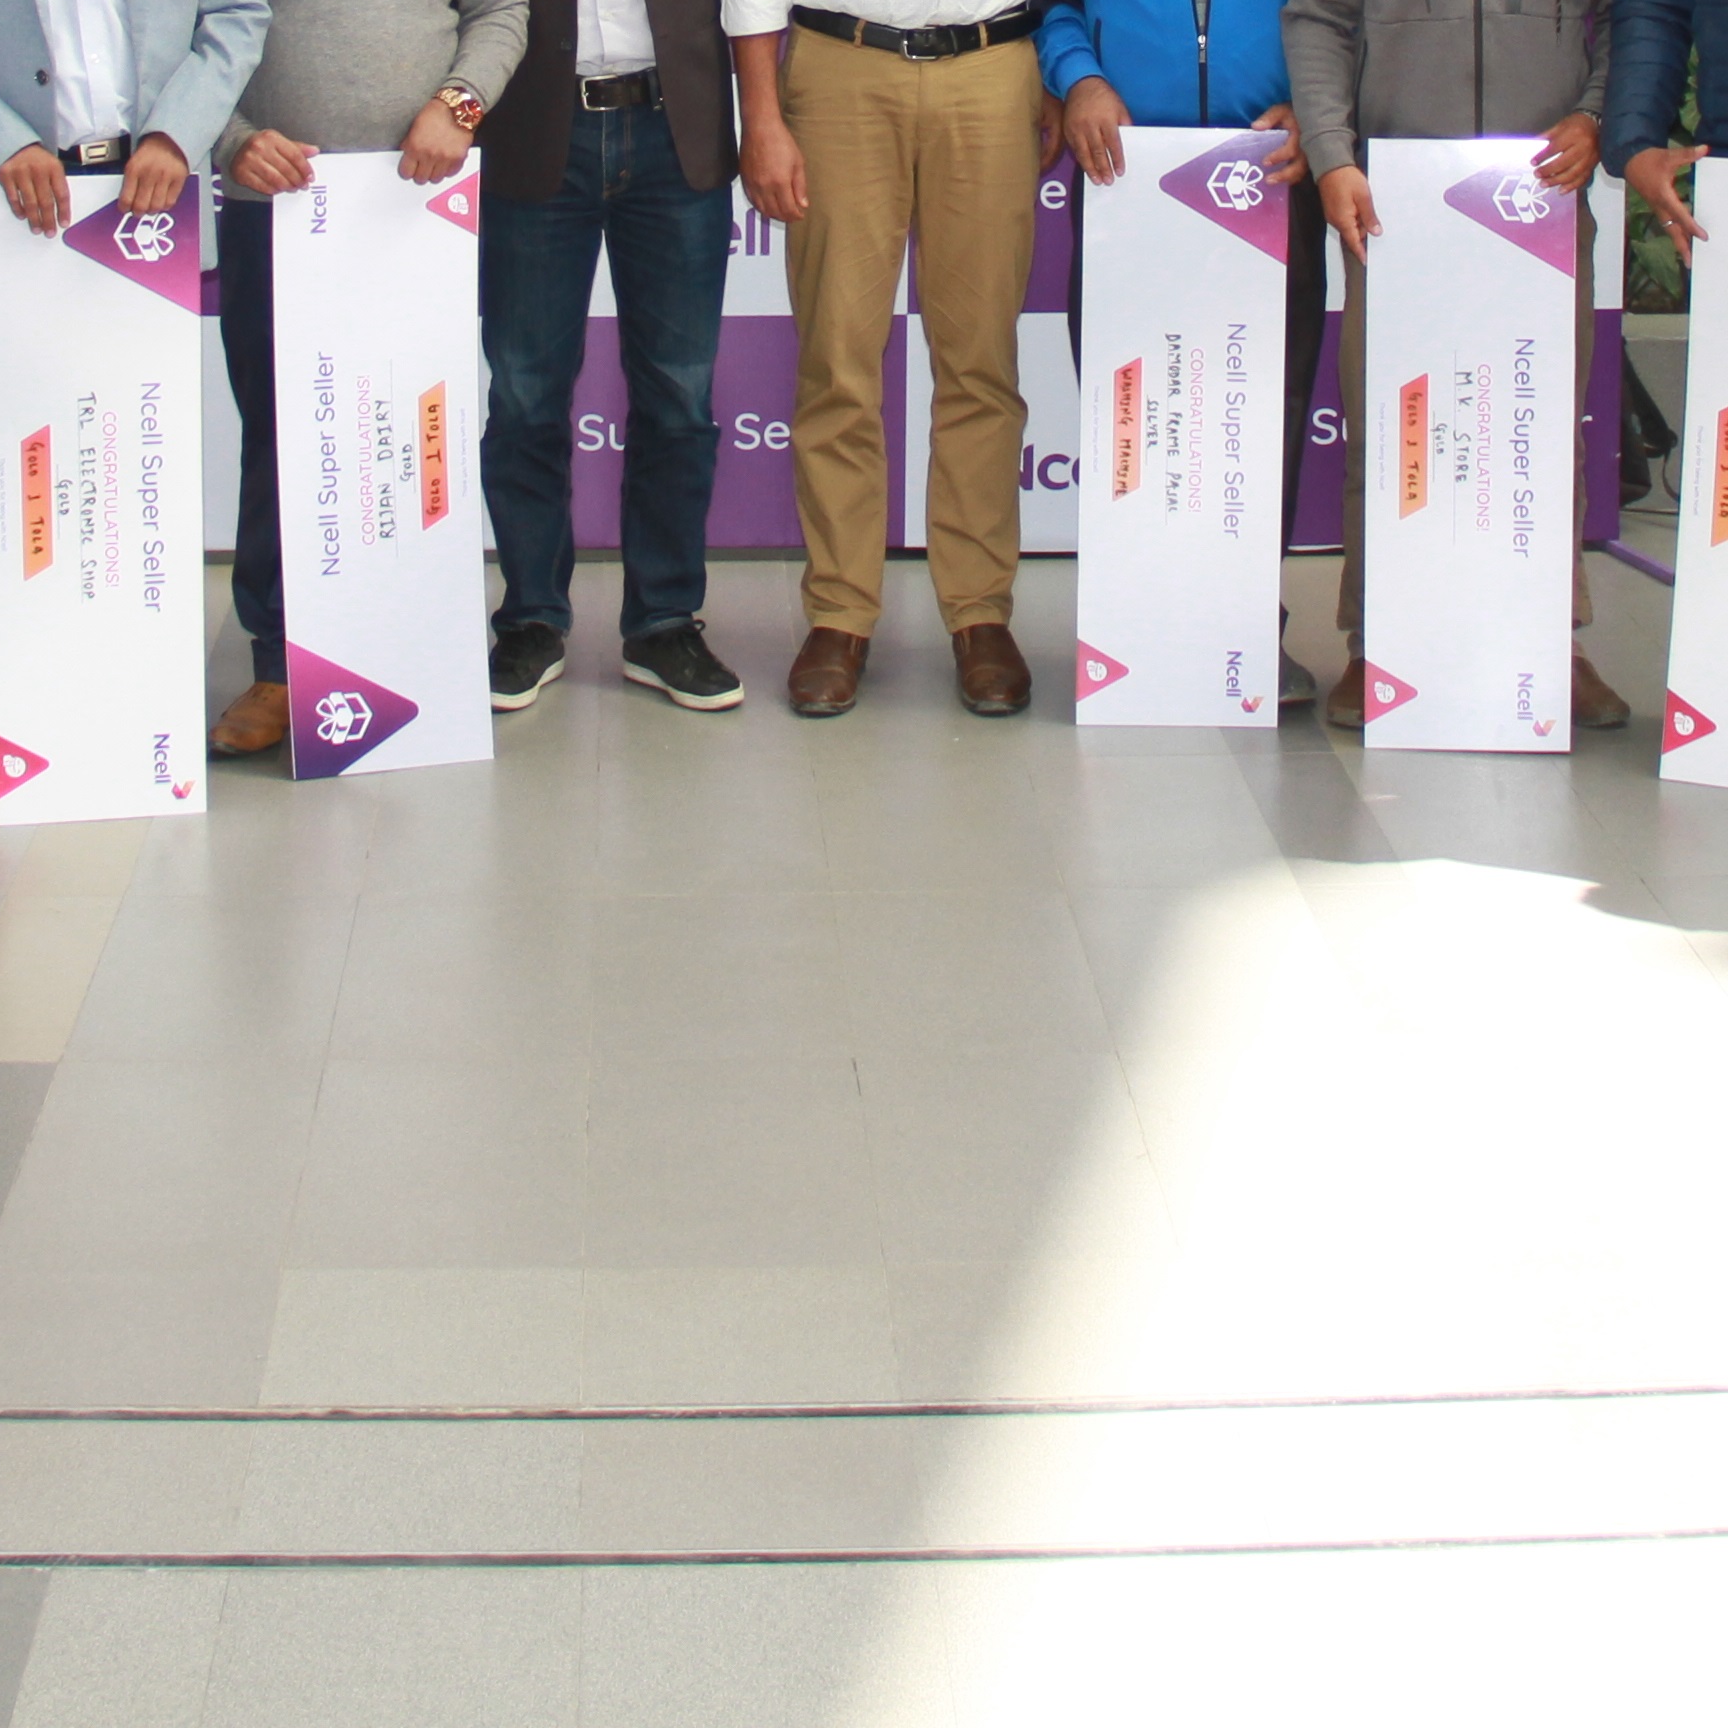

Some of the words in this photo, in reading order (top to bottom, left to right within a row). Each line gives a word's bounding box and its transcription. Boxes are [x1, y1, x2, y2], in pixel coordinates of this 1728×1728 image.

[311, 183, 328, 235] Ncell
[1225, 323, 1247, 383] Ncell
[1514, 338, 1535, 399] Ncell
[141, 382, 163, 445] Ncell
[314, 351, 334, 422] Seller
[375, 400, 393, 461] DAIRY
[426, 404, 440, 443] TOLA
[1168, 412, 1182, 457] FRAME
[1188, 348, 1204, 512] CONGRATULATIONS!
[1220, 392, 1245, 463] Super
[1476, 364, 1491, 532] CONGRATULATIONS!
[1509, 407, 1534, 481] Super
[27, 442, 44, 477] GOLD
[318, 431, 341, 505] Super
[357, 375, 375, 545] CONGRATULATIONS!
[400, 443, 413, 482] GOLD
[1406, 461, 1419, 500] TOLA
[1453, 430, 1471, 482] STORE
[55, 479, 72, 516] GOLD
[102, 411, 119, 588] CONGRATULATIONS!
[137, 455, 163, 532] Super
[426, 479, 440, 515] GOLD
[1224, 471, 1244, 538] Seller
[1513, 489, 1534, 557] Seller
[30, 517, 44, 554] TOLA
[318, 514, 341, 576] Ncell
[143, 539, 165, 613] Seller
[1225, 651, 1244, 698] Ncell
[1515, 672, 1534, 722] Ncell
[154, 732, 172, 785] Ncell
